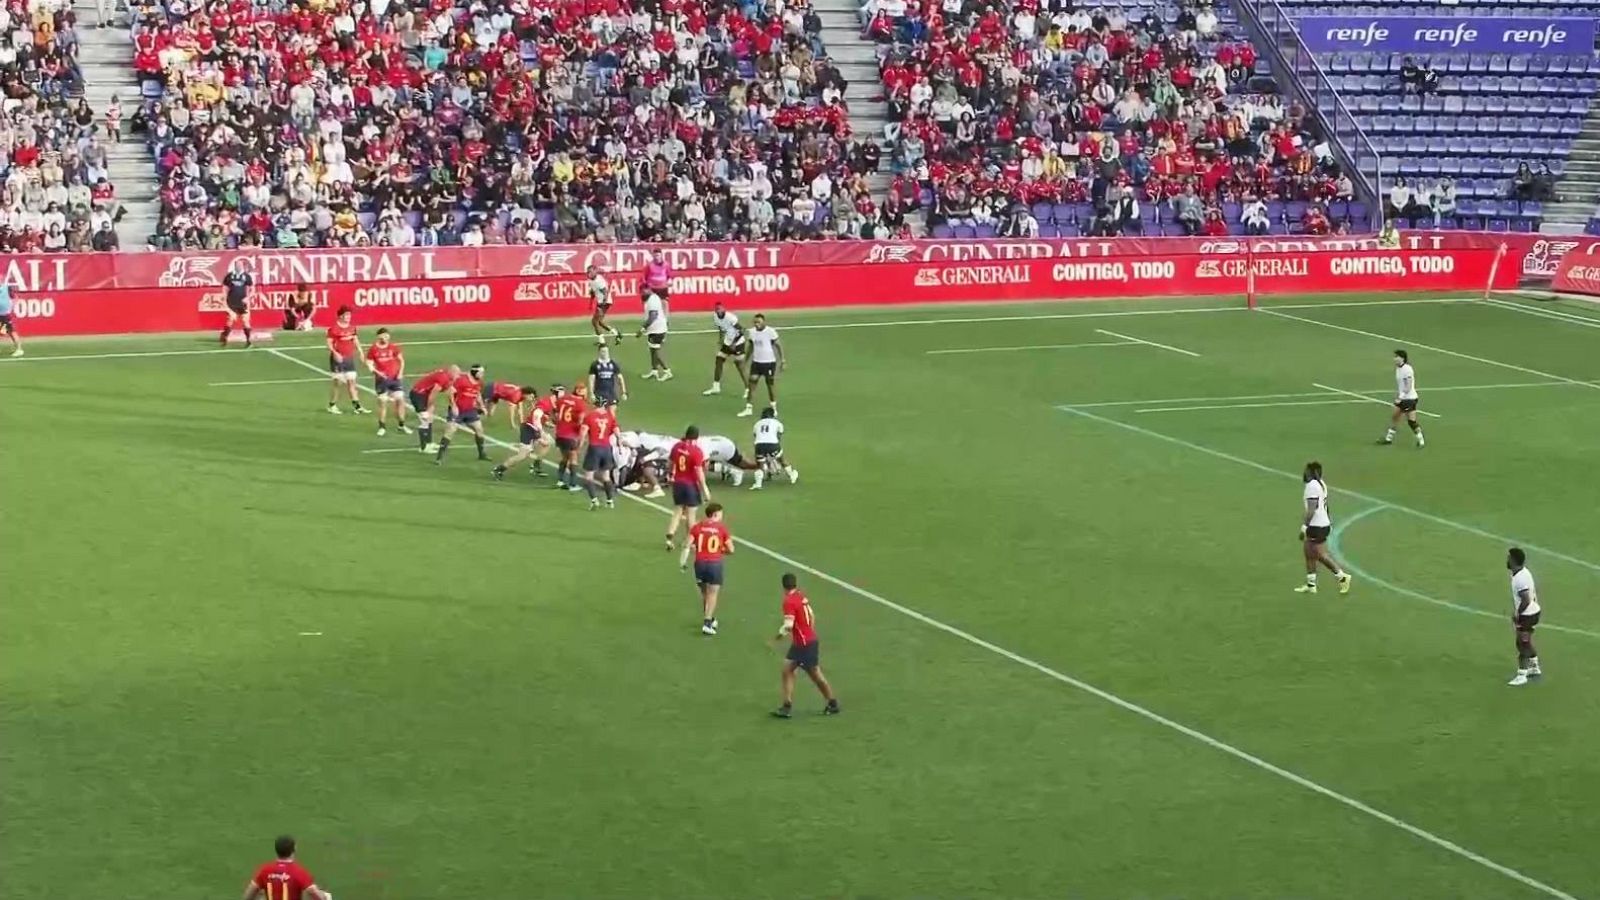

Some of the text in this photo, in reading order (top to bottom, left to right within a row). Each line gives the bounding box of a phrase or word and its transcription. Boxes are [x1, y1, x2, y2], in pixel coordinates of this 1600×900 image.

[1326, 21, 1566, 48] renfe renfe renfe
[942, 264, 1031, 285] GENERALI
[1052, 260, 1175, 283] CONTIGO, TODO
[1330, 255, 1454, 277] CONTIGO, TODO
[543, 278, 637, 300] GENEALI
[743, 272, 790, 292] TODO
[354, 284, 491, 307] CONTIGO, TODO
[13, 298, 55, 318] ODO
[679, 455, 687, 472] 8
[698, 533, 720, 553] 10
[267, 882, 288, 900] 11
